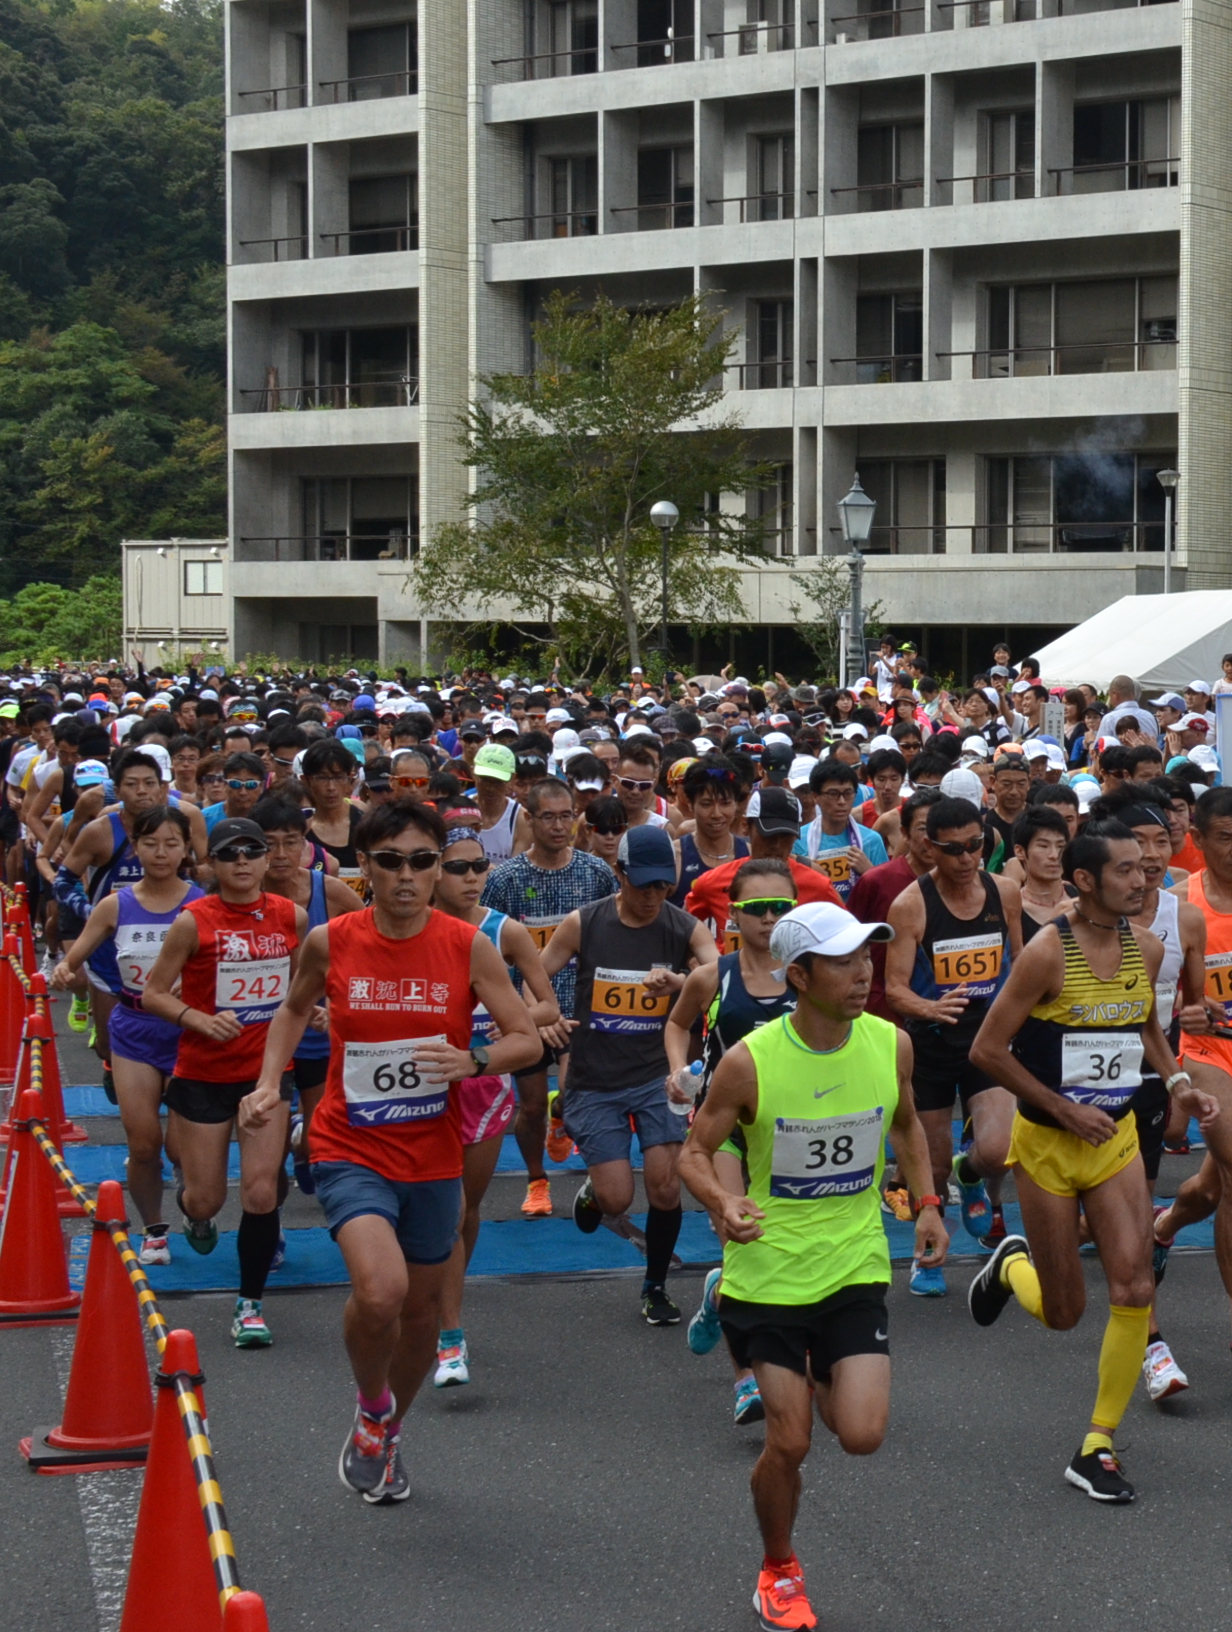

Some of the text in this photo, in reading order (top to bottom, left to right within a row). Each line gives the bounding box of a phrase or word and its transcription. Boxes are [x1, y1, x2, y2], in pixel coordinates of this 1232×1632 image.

[940, 950, 998, 978] 1651
[230, 974, 282, 1001] 242
[360, 1002, 384, 1011] SHALL
[385, 1003, 400, 1011] RUN
[402, 1003, 411, 1012] TO
[412, 1004, 432, 1013] BURN
[433, 1006, 448, 1014] OUT
[1069, 1000, 1146, 1022] ランバロウズ
[373, 1060, 421, 1092] 68
[1087, 1053, 1123, 1080] 36
[805, 1135, 854, 1169] 38
